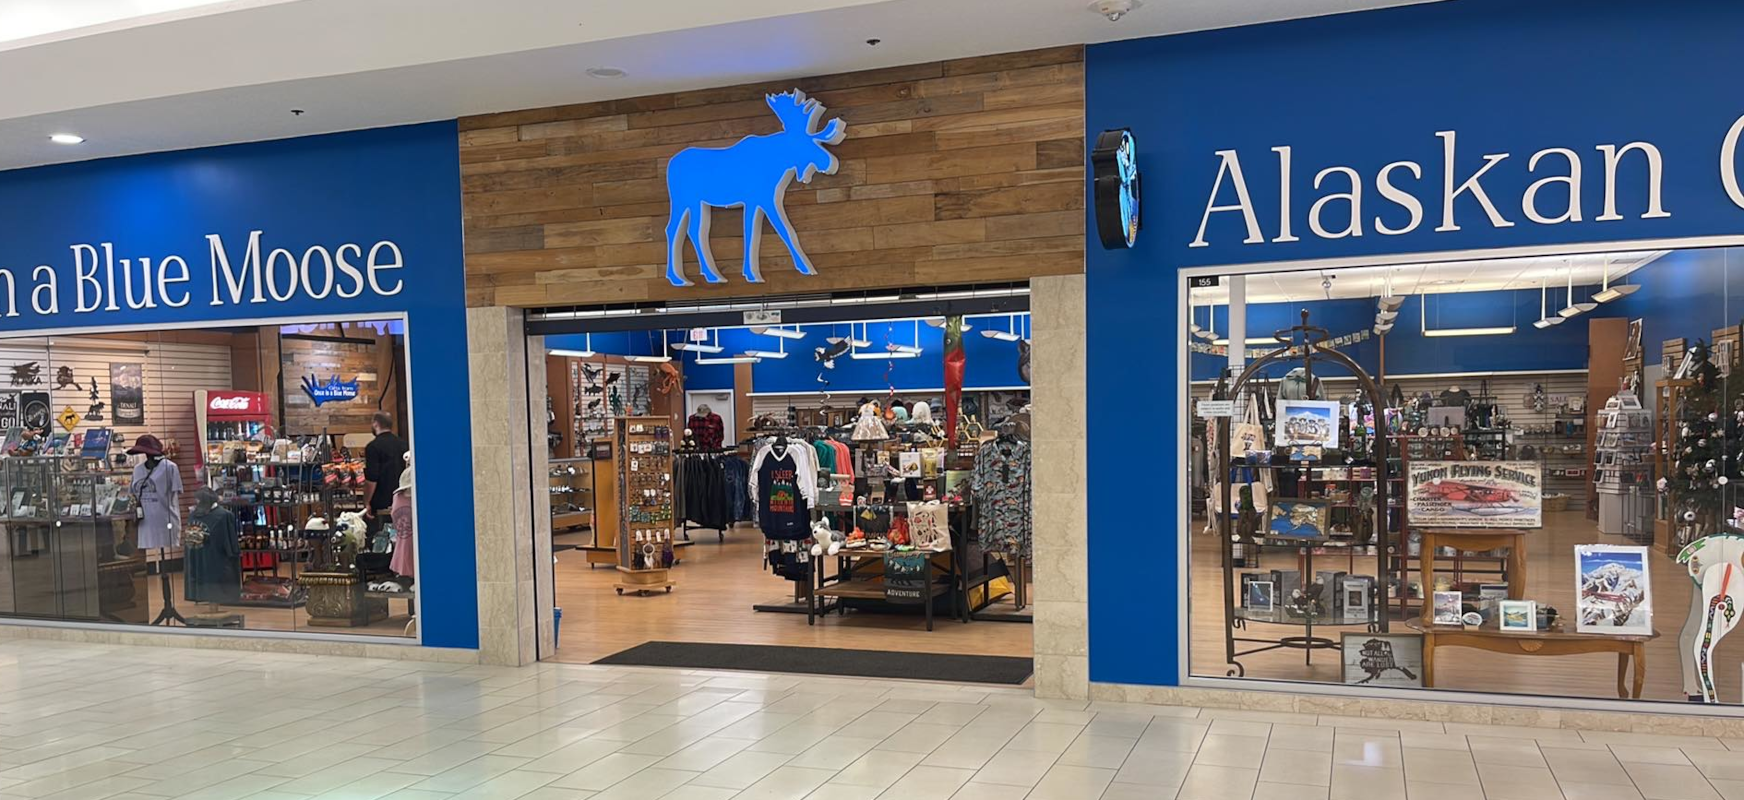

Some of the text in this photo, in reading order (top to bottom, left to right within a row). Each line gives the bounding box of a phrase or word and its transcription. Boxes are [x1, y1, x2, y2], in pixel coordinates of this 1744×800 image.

[1188, 129, 1671, 248] Alaskan
[31, 264, 59, 316] a
[69, 242, 191, 313] Blue
[205, 230, 404, 306] Moose
[1198, 278, 1212, 287] 155
[1411, 464, 1537, 489] YUKON FLYING SERVICE
[886, 588, 921, 598] ADVENTURE
